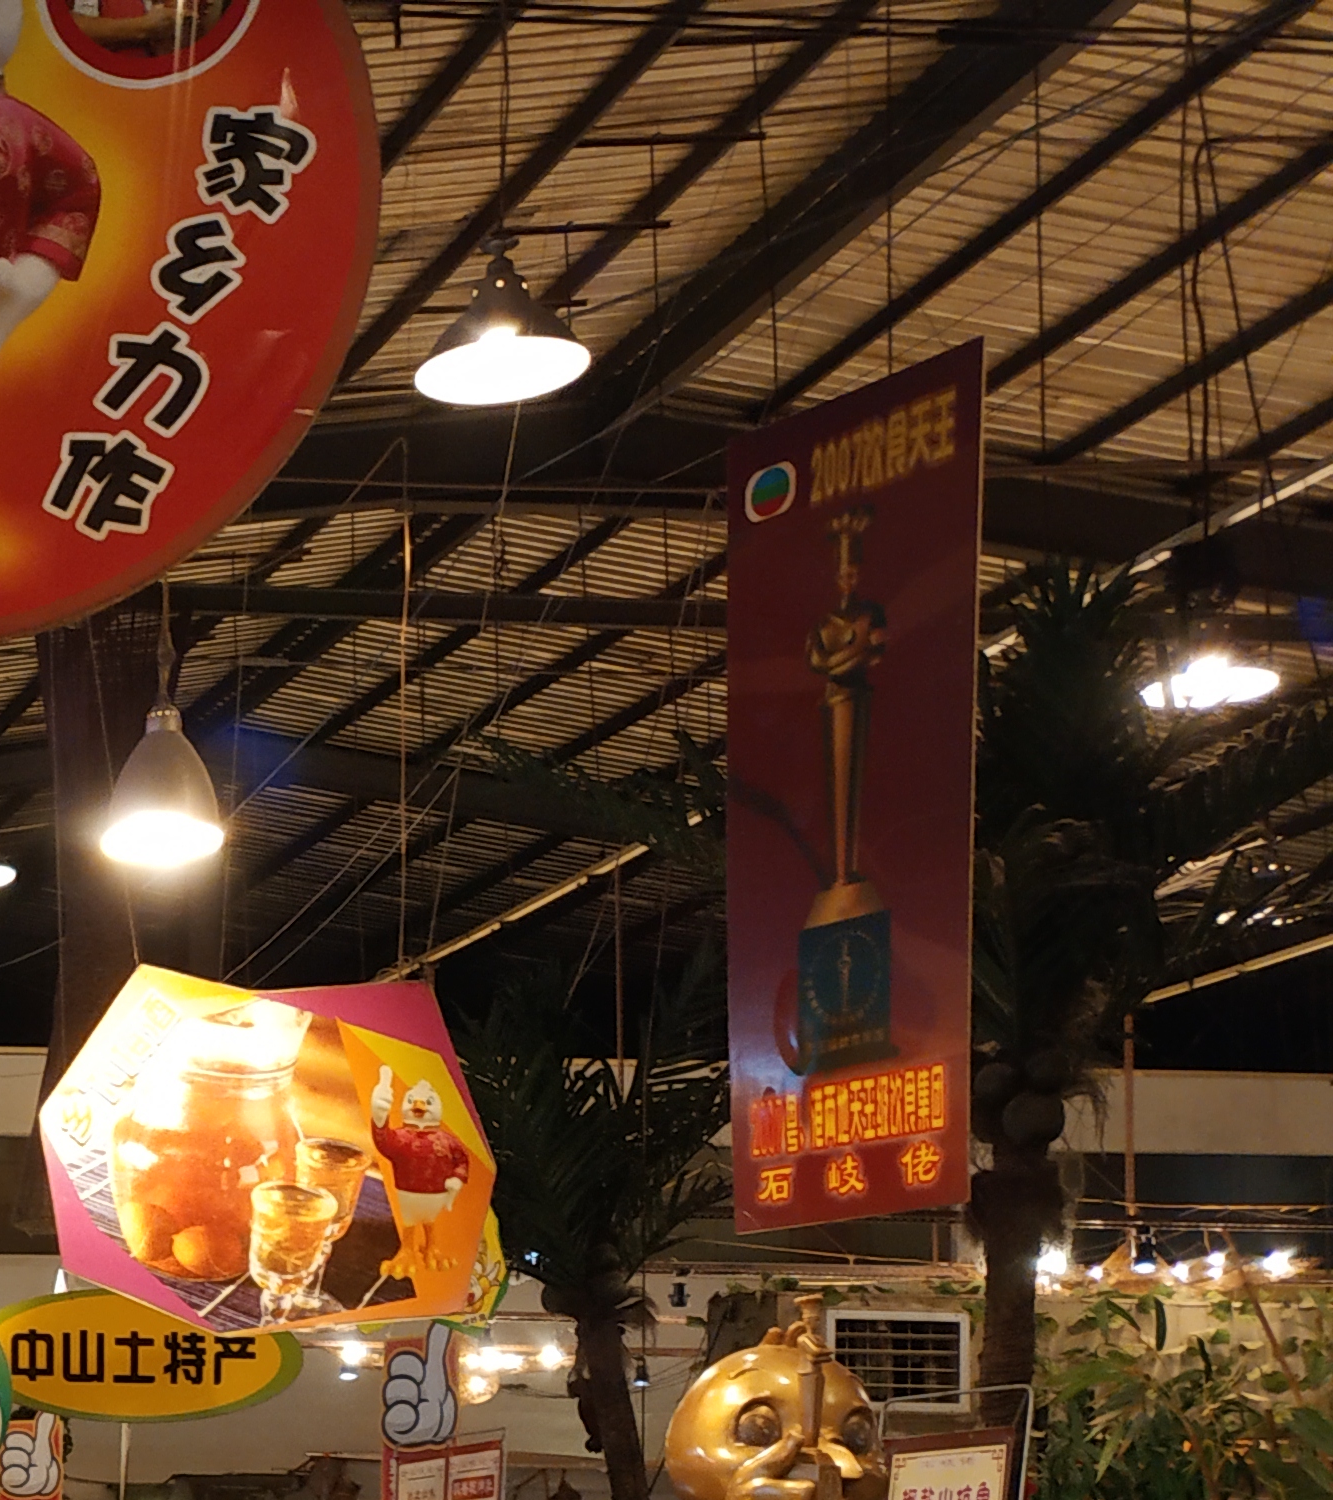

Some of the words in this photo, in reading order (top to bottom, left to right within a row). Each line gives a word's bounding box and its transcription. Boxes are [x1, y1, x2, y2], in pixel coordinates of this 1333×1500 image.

[44, 105, 317, 541] 家乡力作
[758, 1142, 941, 1201] 石岐佬
[9, 1328, 258, 1386] 中山土特产
